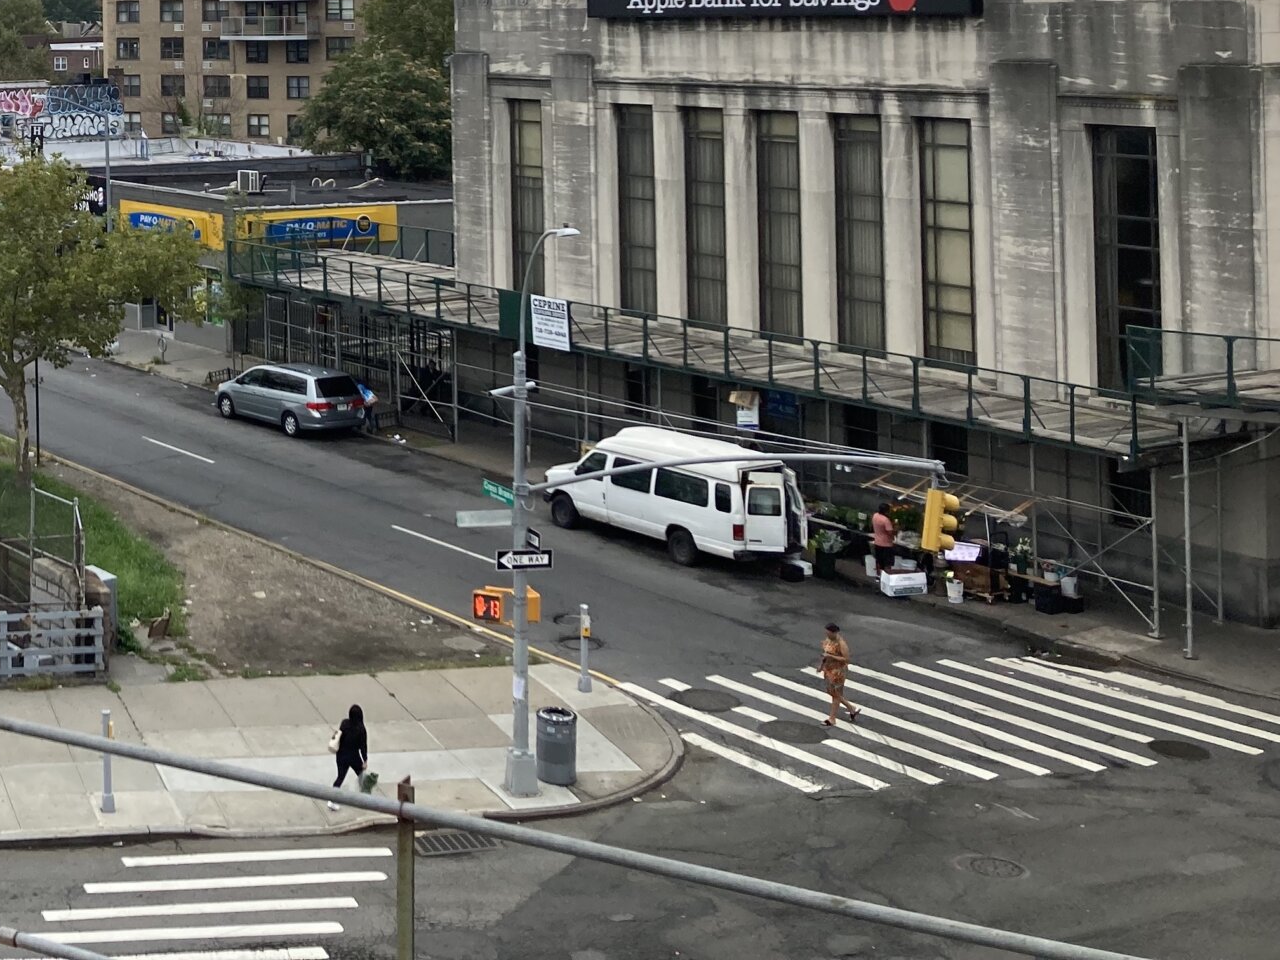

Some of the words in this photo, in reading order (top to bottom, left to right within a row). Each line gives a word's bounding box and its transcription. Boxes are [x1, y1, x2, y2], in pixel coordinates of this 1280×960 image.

[532, 298, 566, 312] CEPRINE
[506, 555, 524, 565] ONE
[528, 554, 545, 564] WAY
